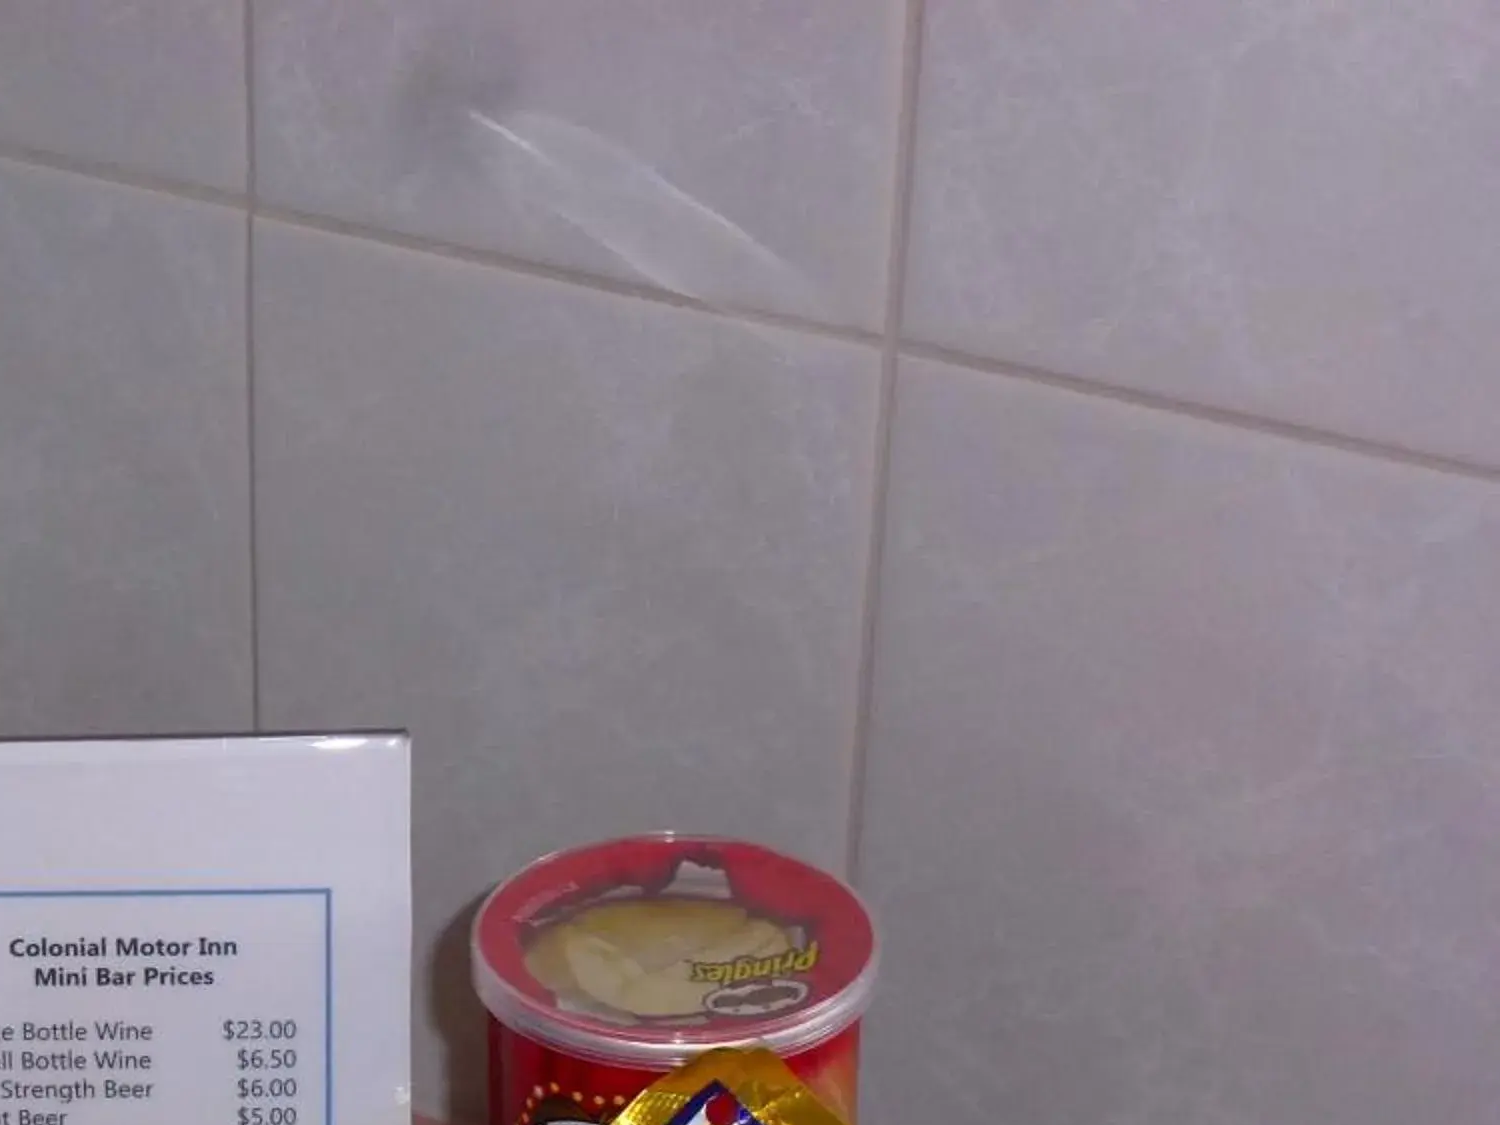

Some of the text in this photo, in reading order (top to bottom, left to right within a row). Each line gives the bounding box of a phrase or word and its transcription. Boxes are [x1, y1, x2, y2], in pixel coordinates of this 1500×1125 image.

[10, 937, 237, 957] Colonial Motor Inn
[689, 939, 819, 984] Pringles
[35, 966, 214, 986] Mini Bar Prices
[23, 1021, 87, 1041] Bottle
[95, 1021, 152, 1040] Wine
[223, 1020, 297, 1041] $23.00
[21, 1050, 86, 1070] Bottle
[93, 1051, 151, 1069] Wine
[238, 1049, 297, 1070] $6.50
[1, 1079, 95, 1104] Strength
[104, 1080, 152, 1098] Beer
[238, 1078, 297, 1099] $6.00
